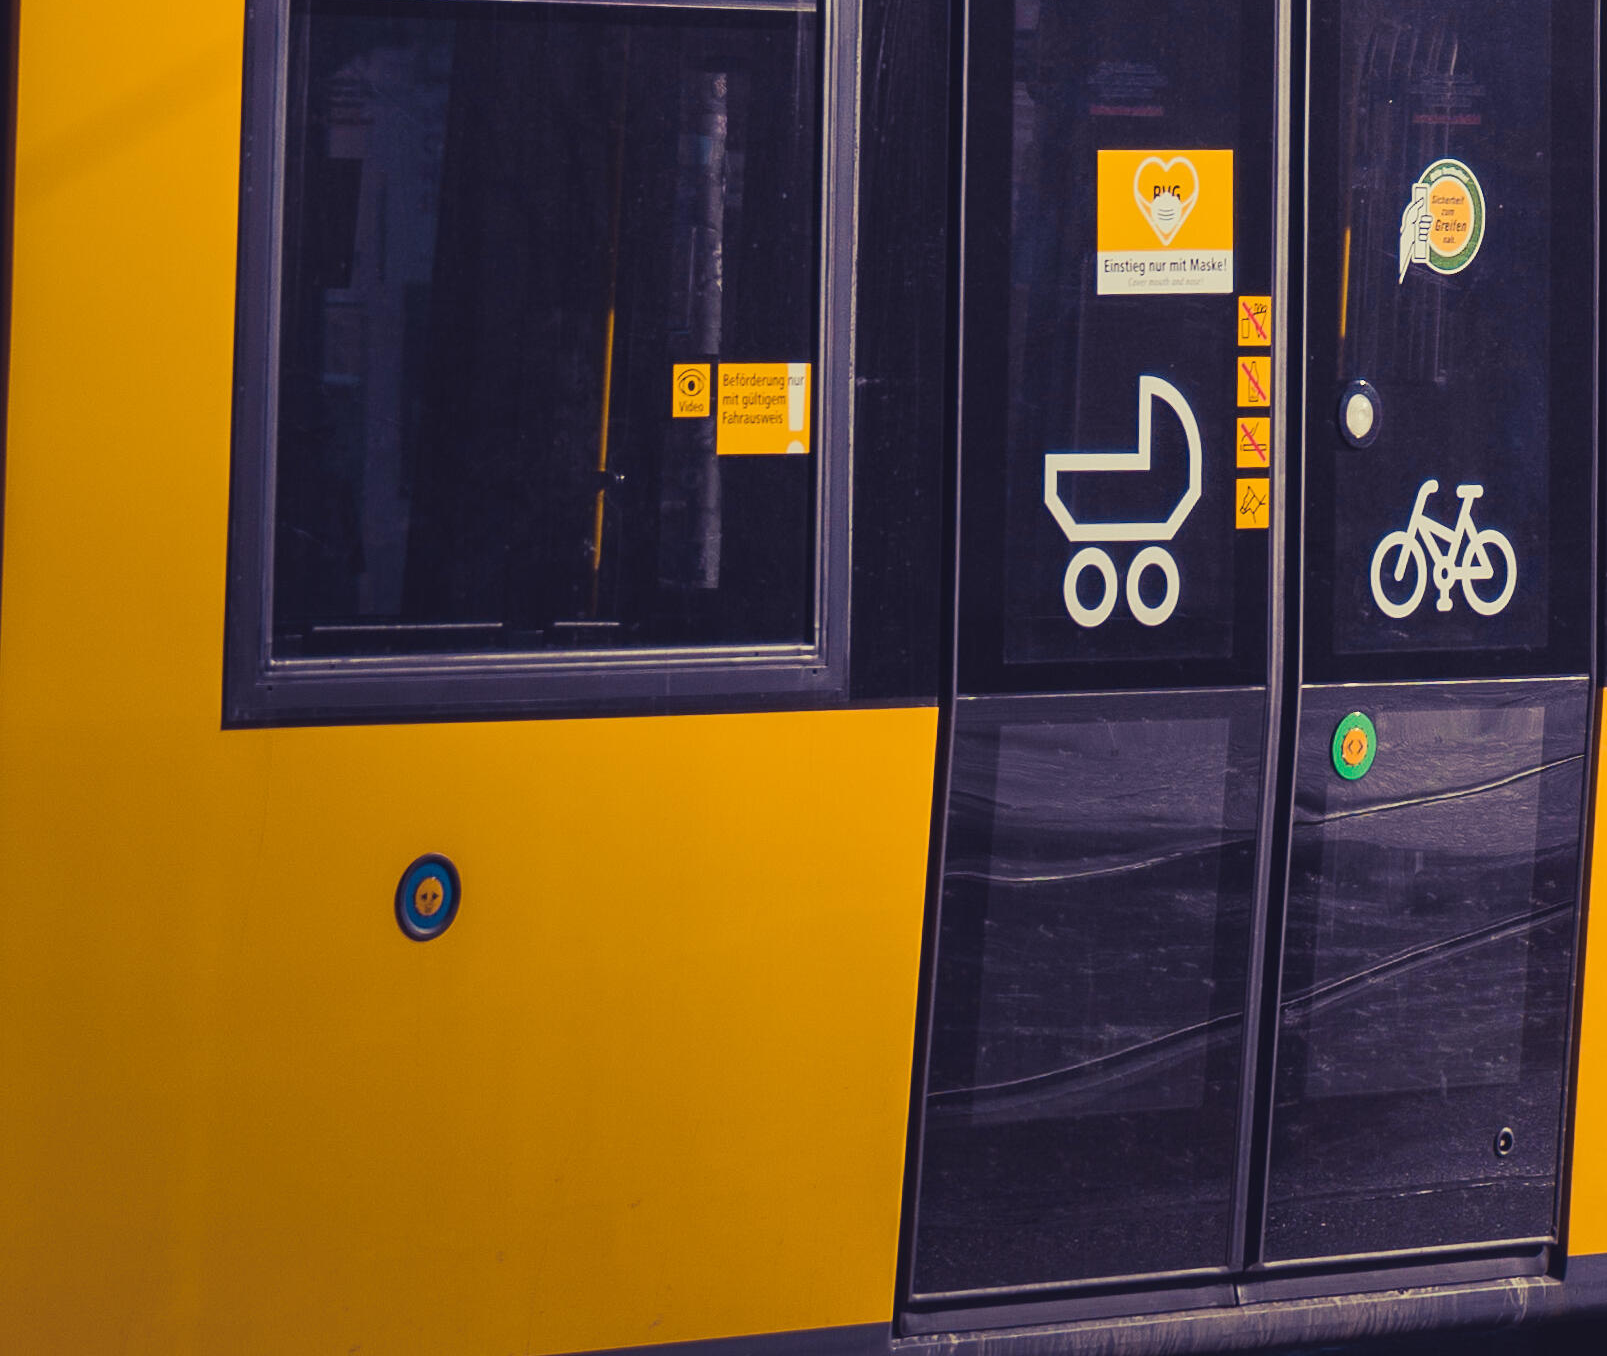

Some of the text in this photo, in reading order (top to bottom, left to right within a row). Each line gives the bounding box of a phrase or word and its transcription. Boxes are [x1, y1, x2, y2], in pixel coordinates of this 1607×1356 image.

[1435, 219, 1467, 233] Greifen
[1104, 257, 1227, 276] Einstieg nur mit Maske!
[722, 373, 805, 390] Beförderung nur
[679, 401, 704, 413] Video
[722, 394, 786, 409] mit gültigem
[722, 411, 783, 424] Fahrausweis
